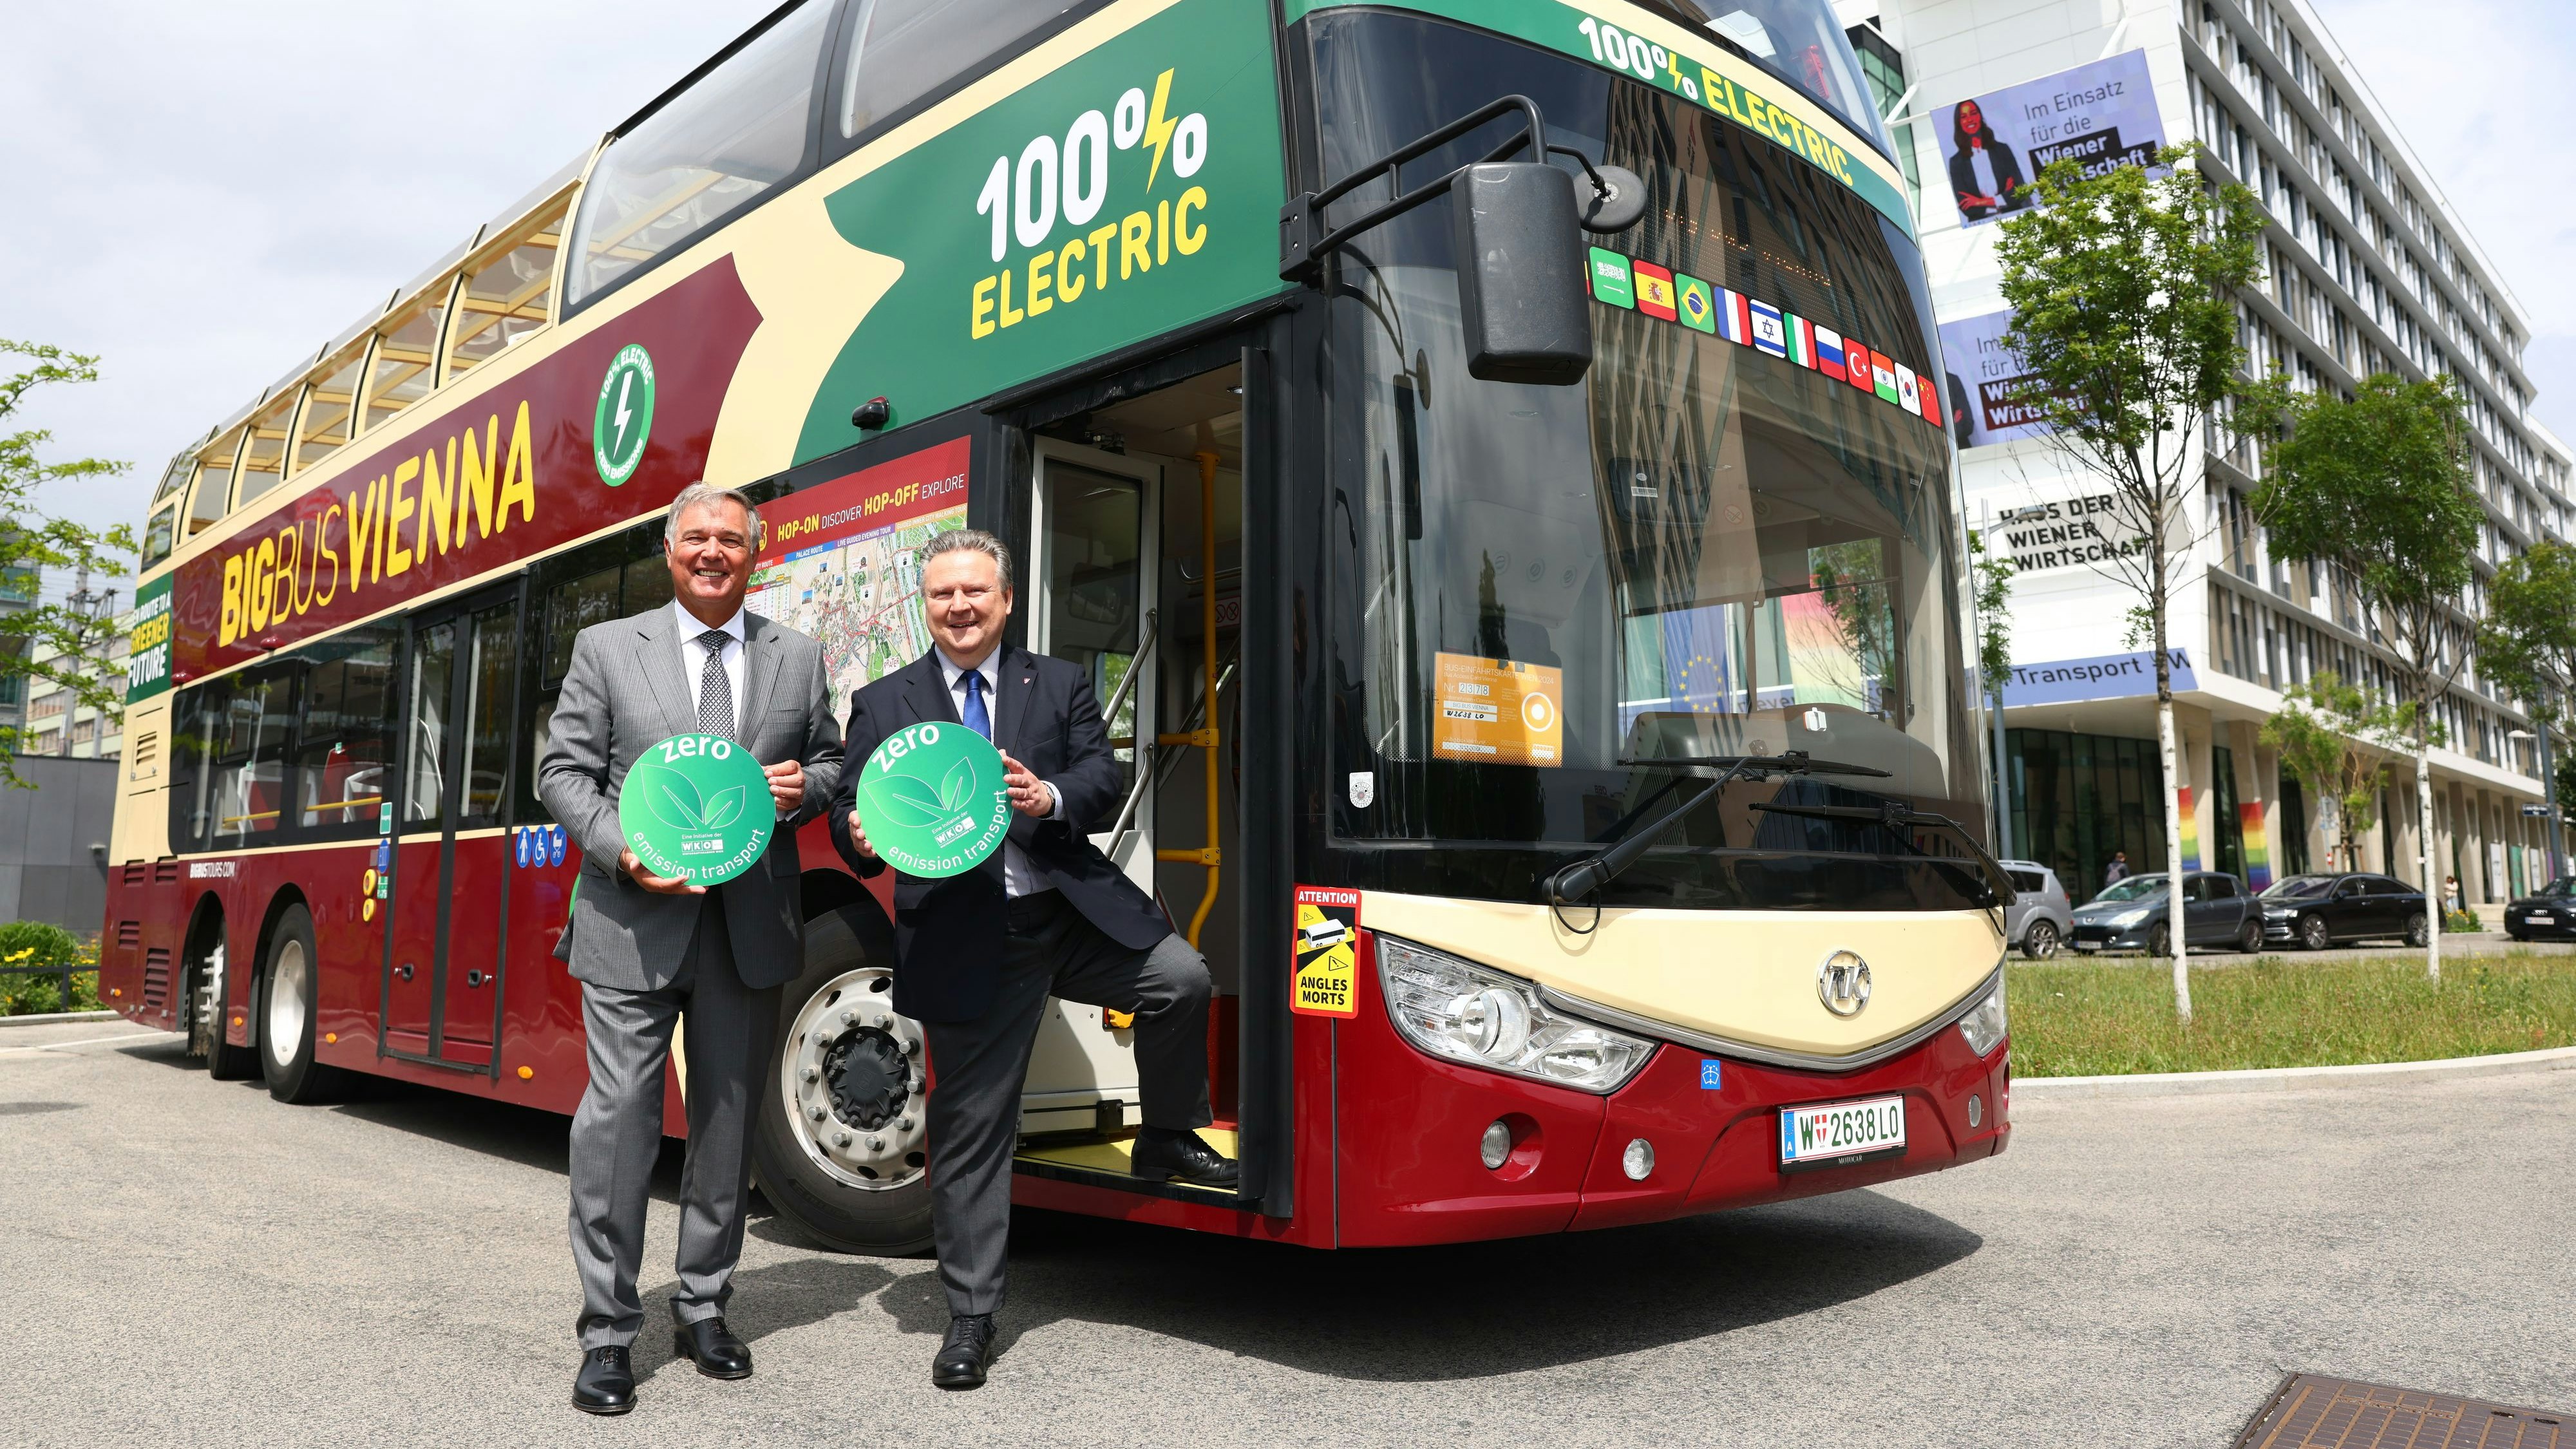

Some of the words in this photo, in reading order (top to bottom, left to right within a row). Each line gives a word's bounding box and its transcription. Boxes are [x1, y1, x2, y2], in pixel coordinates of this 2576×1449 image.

[1578, 17, 1698, 101] 100%
[1700, 66, 1853, 187] ELECTRIC
[2024, 104, 2049, 120] Im
[2054, 82, 2125, 113] Einsatz
[2031, 125, 2057, 144] für
[2063, 115, 2091, 135] die
[2034, 135, 2107, 167] Wiener
[976, 67, 1208, 263] 100%
[971, 185, 1208, 340] ELECTRIC
[600, 361, 620, 399] 100%
[620, 347, 652, 385] ELECTRIC
[1982, 360, 2007, 377] für
[598, 447, 610, 476] ZERO
[610, 438, 643, 479] EMISSIONS
[777, 514, 819, 542] HOP-ON
[822, 506, 862, 529] DISCOVER
[864, 482, 920, 516] HOP-OFF
[922, 473, 965, 499] EXPLORE
[896, 520, 912, 529] GUIDED
[912, 517, 925, 526] INNER
[934, 509, 954, 520] WALKING
[954, 505, 967, 514] TOUR
[2067, 495, 2116, 516] DER
[837, 538, 846, 547] LIVE
[846, 535, 862, 545] GUIDED
[862, 530, 880, 541] EVENING
[880, 526, 891, 535] TOUR
[2007, 522, 2098, 549] WIENER
[761, 560, 773, 569] ROUTE
[796, 549, 811, 559] PALACE
[810, 545, 823, 555] ROUTE
[140, 597, 159, 623] ROUTE
[159, 592, 167, 613] TO
[166, 591, 171, 609] A
[131, 612, 169, 655] GREENER
[126, 643, 167, 690] FUTURE
[884, 658, 900, 668] PRATER
[1444, 663, 1519, 679] BUS-EINFAHRTSKARTE
[2012, 658, 2142, 685] Transport
[1444, 683, 1455, 693] Nr.
[1459, 683, 1489, 696] 2378
[658, 736, 731, 764] zero
[871, 724, 940, 773] zero
[888, 846, 963, 871] emission
[964, 790, 1007, 860] transport
[936, 824, 963, 844] WKO
[942, 816, 960, 828] Initiative
[633, 832, 696, 879] emission
[701, 829, 764, 879] transport
[682, 841, 712, 851] WKO
[1298, 889, 1357, 904] ATTENTION
[1300, 976, 1348, 992] ANGLES
[1302, 990, 1345, 1006] MORTS
[1786, 1141, 1793, 1152] A
[1838, 1155, 1862, 1165] MOTOCAR
